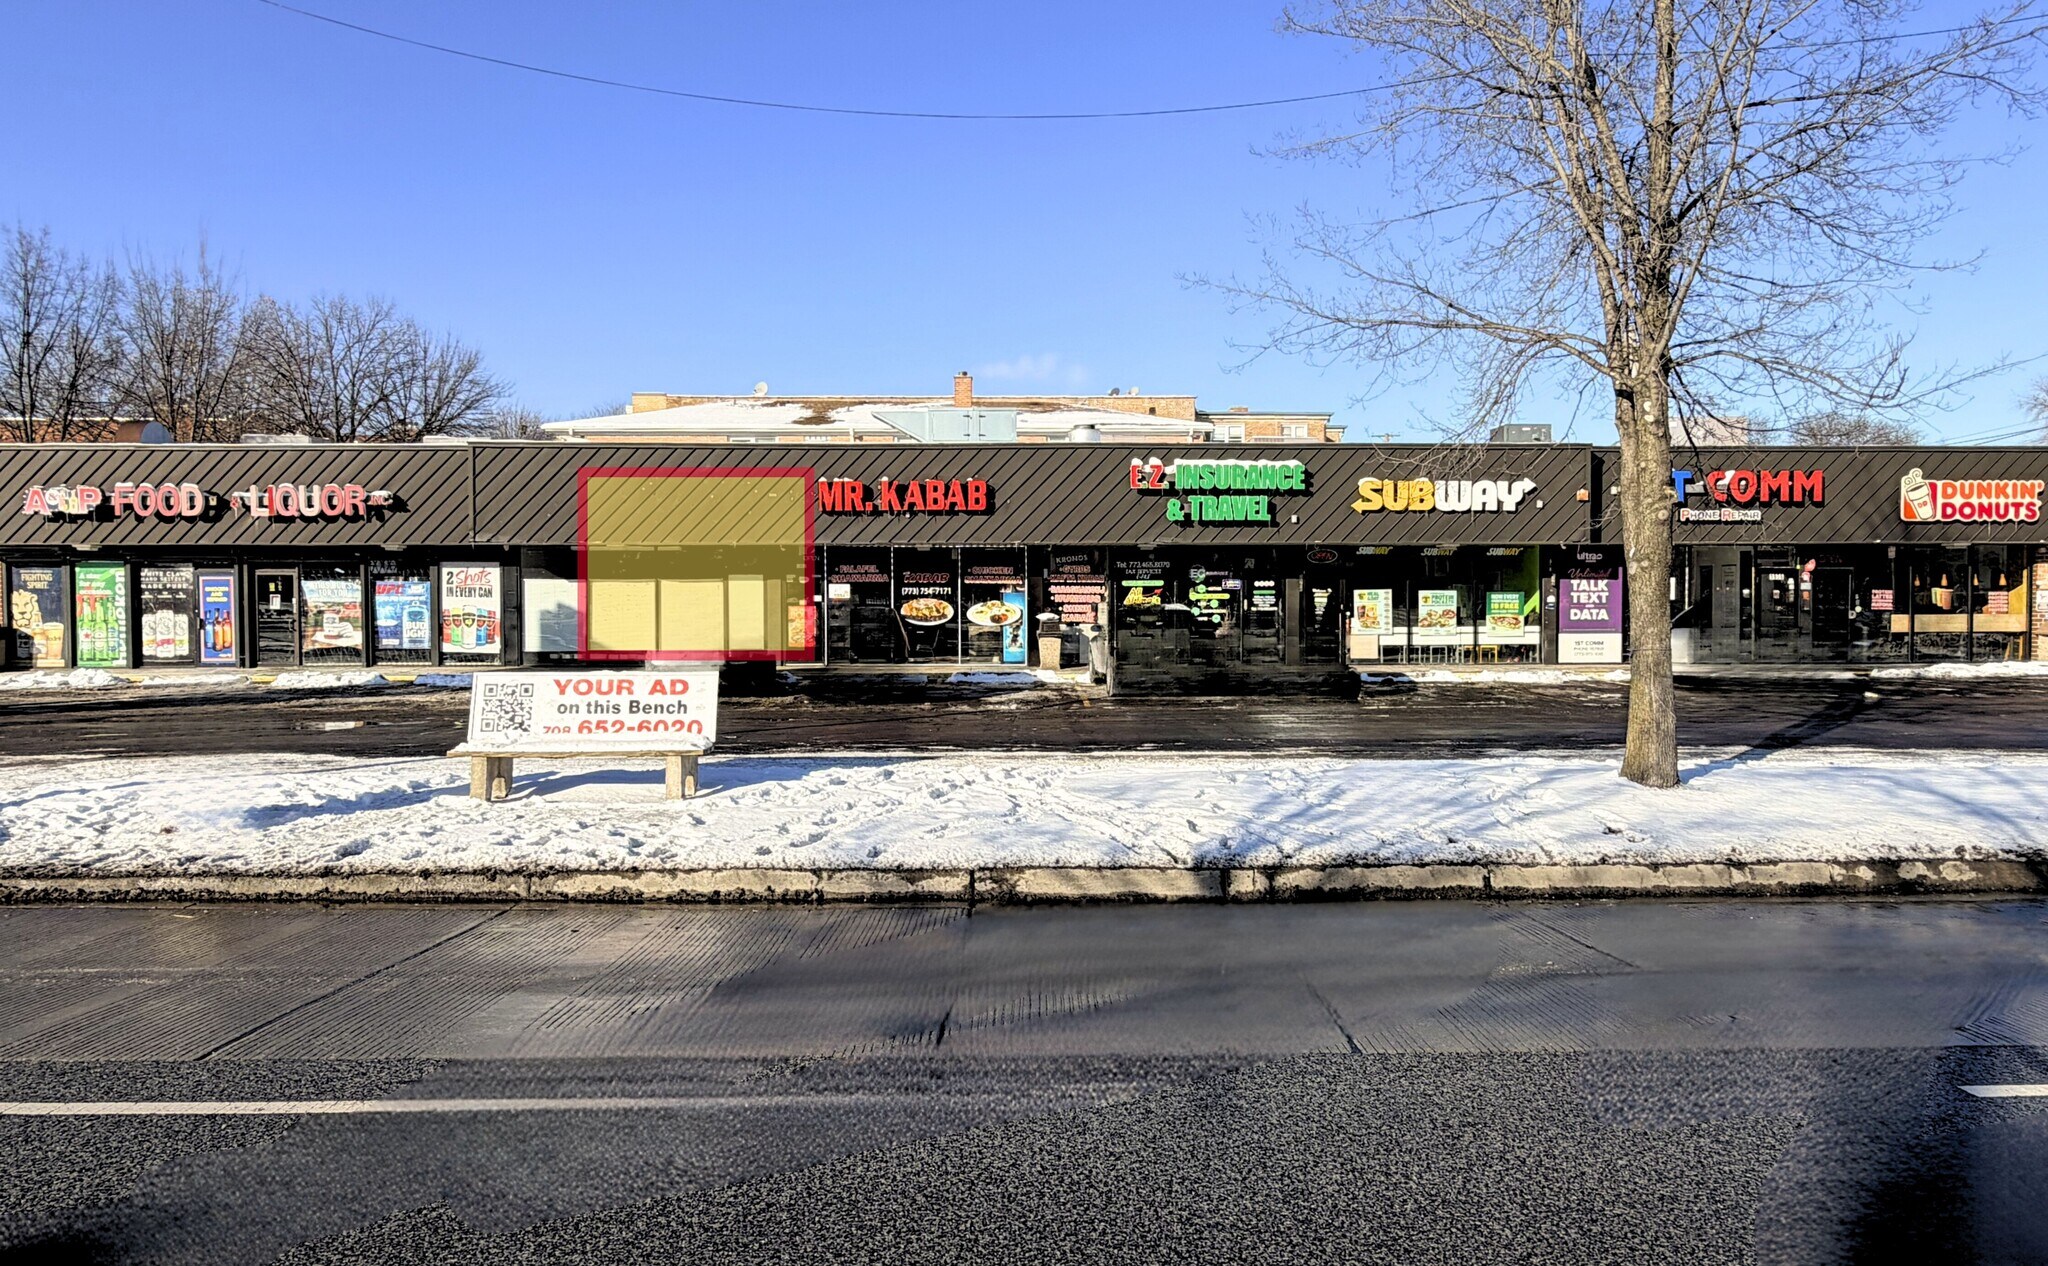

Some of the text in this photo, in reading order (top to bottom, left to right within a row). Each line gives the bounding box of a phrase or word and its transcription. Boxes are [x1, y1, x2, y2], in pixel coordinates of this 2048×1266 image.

[1174, 463, 1305, 490] INSURANCE
[1706, 470, 1824, 502] COMM
[1941, 481, 2043, 500] DUNKIN'
[113, 484, 203, 517] FOOD
[250, 484, 366, 516] LIQUOR
[818, 479, 988, 511] MR. KABAB
[1351, 475, 1538, 514] SUBWAY
[1166, 495, 1271, 521] & TRAVEL
[1680, 508, 1762, 522] PHONE REPAIR
[1941, 501, 2038, 520] DONUTS
[1356, 546, 1394, 555] SUBWAY
[1421, 547, 1457, 556] SUBWAY
[1486, 547, 1524, 556] SUBWAY
[21, 573, 53, 582] FIGHTING
[446, 567, 492, 586] 2 Shots
[446, 586, 493, 598] IN EVERY CAN
[901, 587, 919, 595] (773)
[1570, 580, 1609, 592] TALK
[1570, 592, 1609, 604] TEXT
[1570, 608, 1610, 620] DATA
[553, 678, 690, 696] YOUR AD
[557, 700, 688, 715] on this Bench
[577, 719, 704, 735] 652-6020
